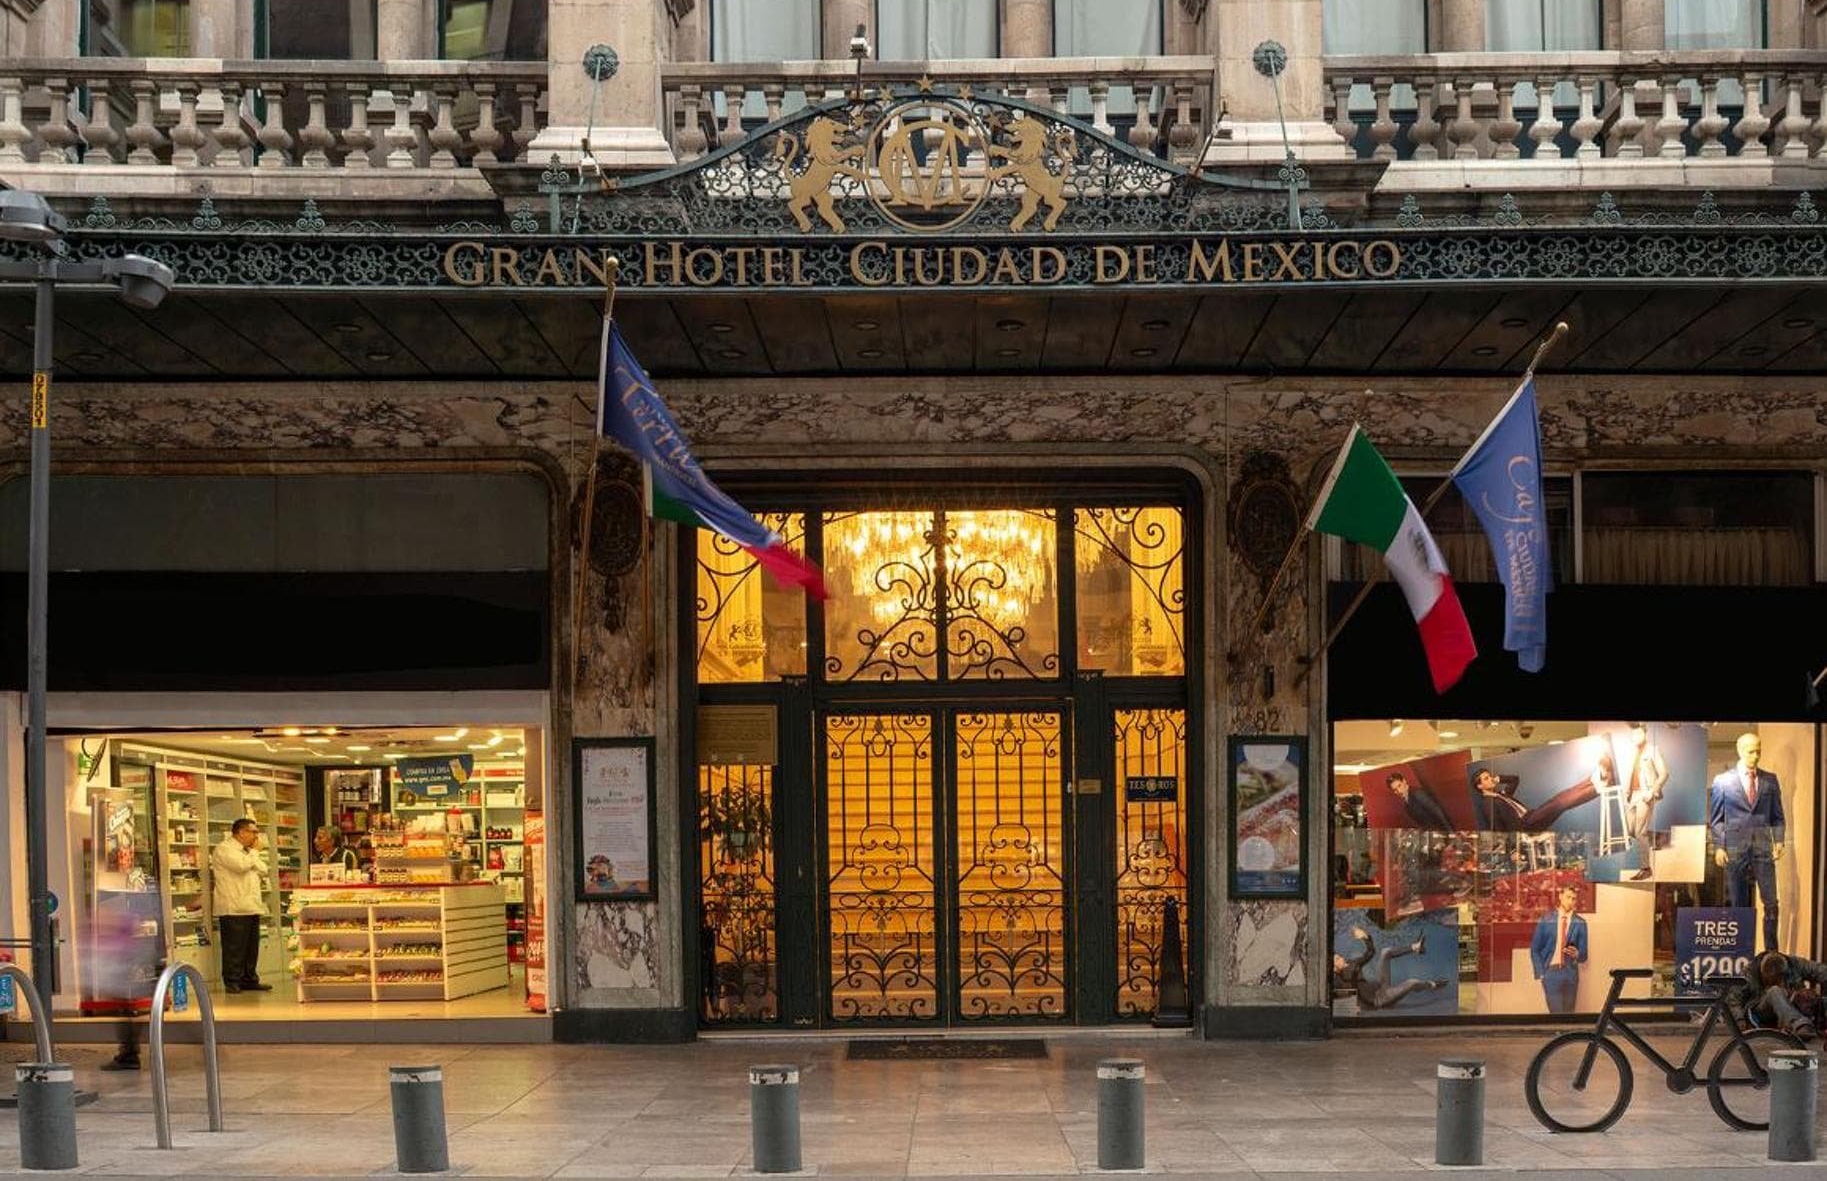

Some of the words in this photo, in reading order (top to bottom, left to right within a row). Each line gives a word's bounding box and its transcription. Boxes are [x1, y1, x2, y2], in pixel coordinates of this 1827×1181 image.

[443, 241, 614, 287] GRAN
[642, 241, 813, 287] HOTEL
[850, 241, 1067, 286] CIUDAD
[1092, 244, 1157, 284] DE
[1184, 237, 1400, 282] MEXICO
[1694, 921, 1739, 936] TRES
[1695, 937, 1737, 946] PRENDAS
